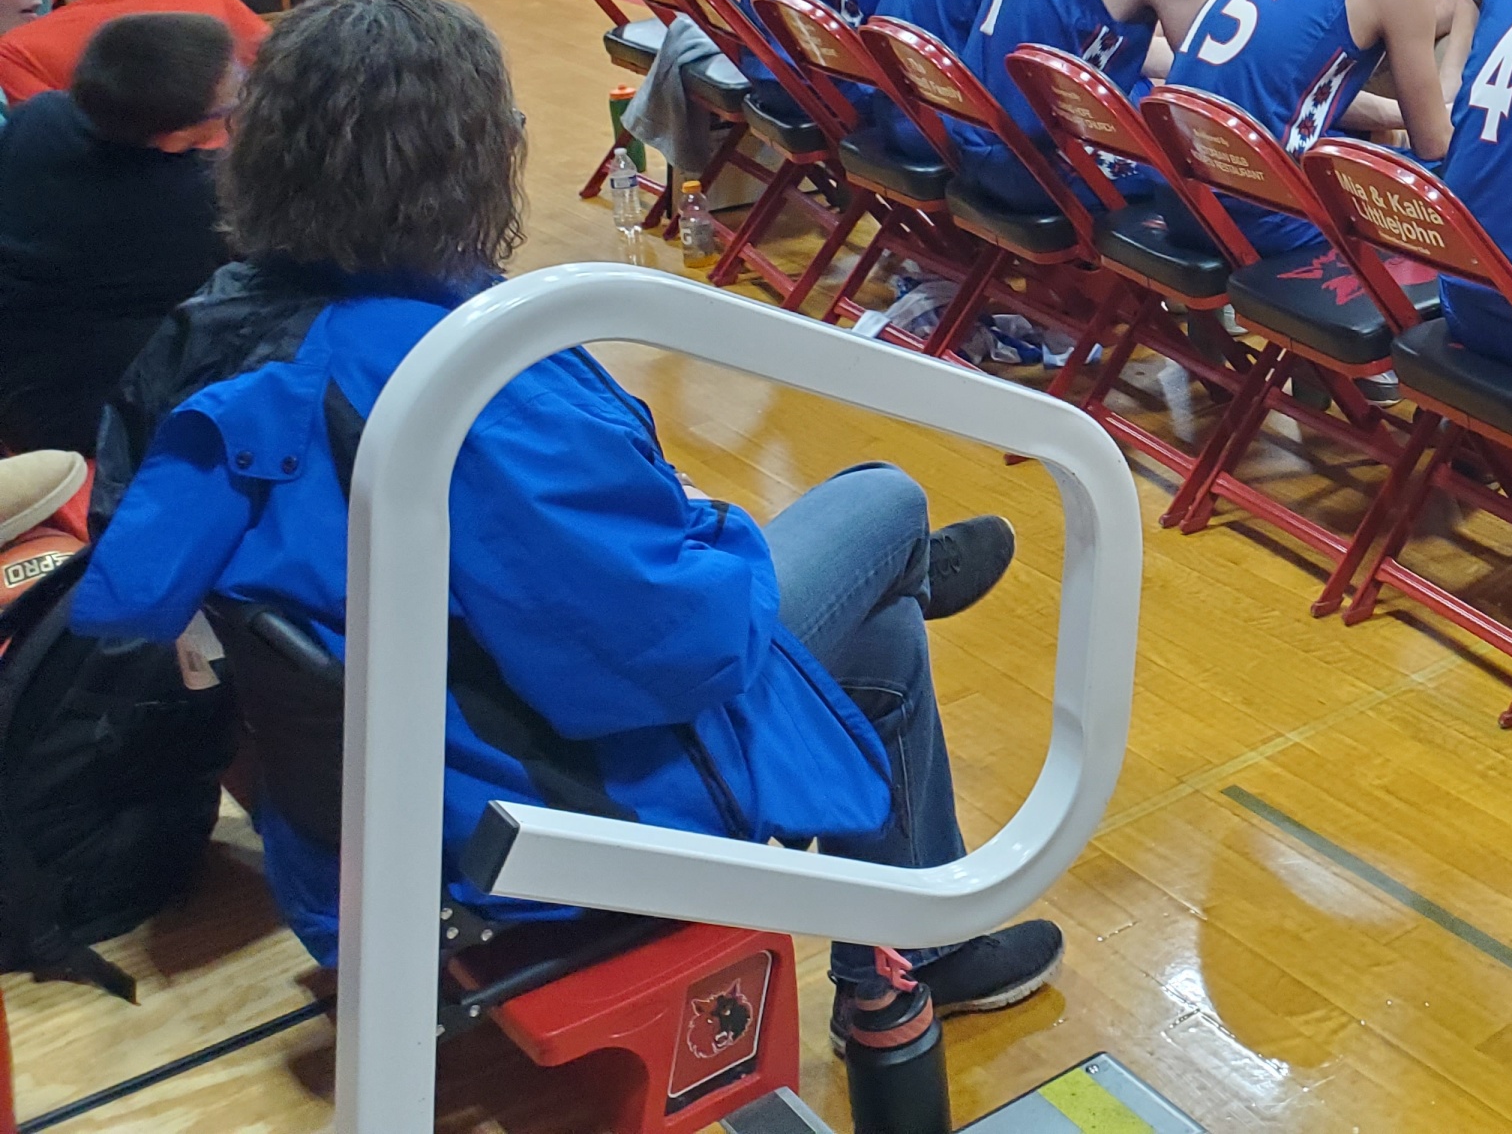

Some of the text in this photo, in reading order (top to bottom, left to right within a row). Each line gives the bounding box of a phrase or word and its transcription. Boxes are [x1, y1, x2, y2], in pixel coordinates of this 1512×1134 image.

[1335, 169, 1445, 226] Mia & Kalia
[1352, 196, 1446, 248] Littlejohn
